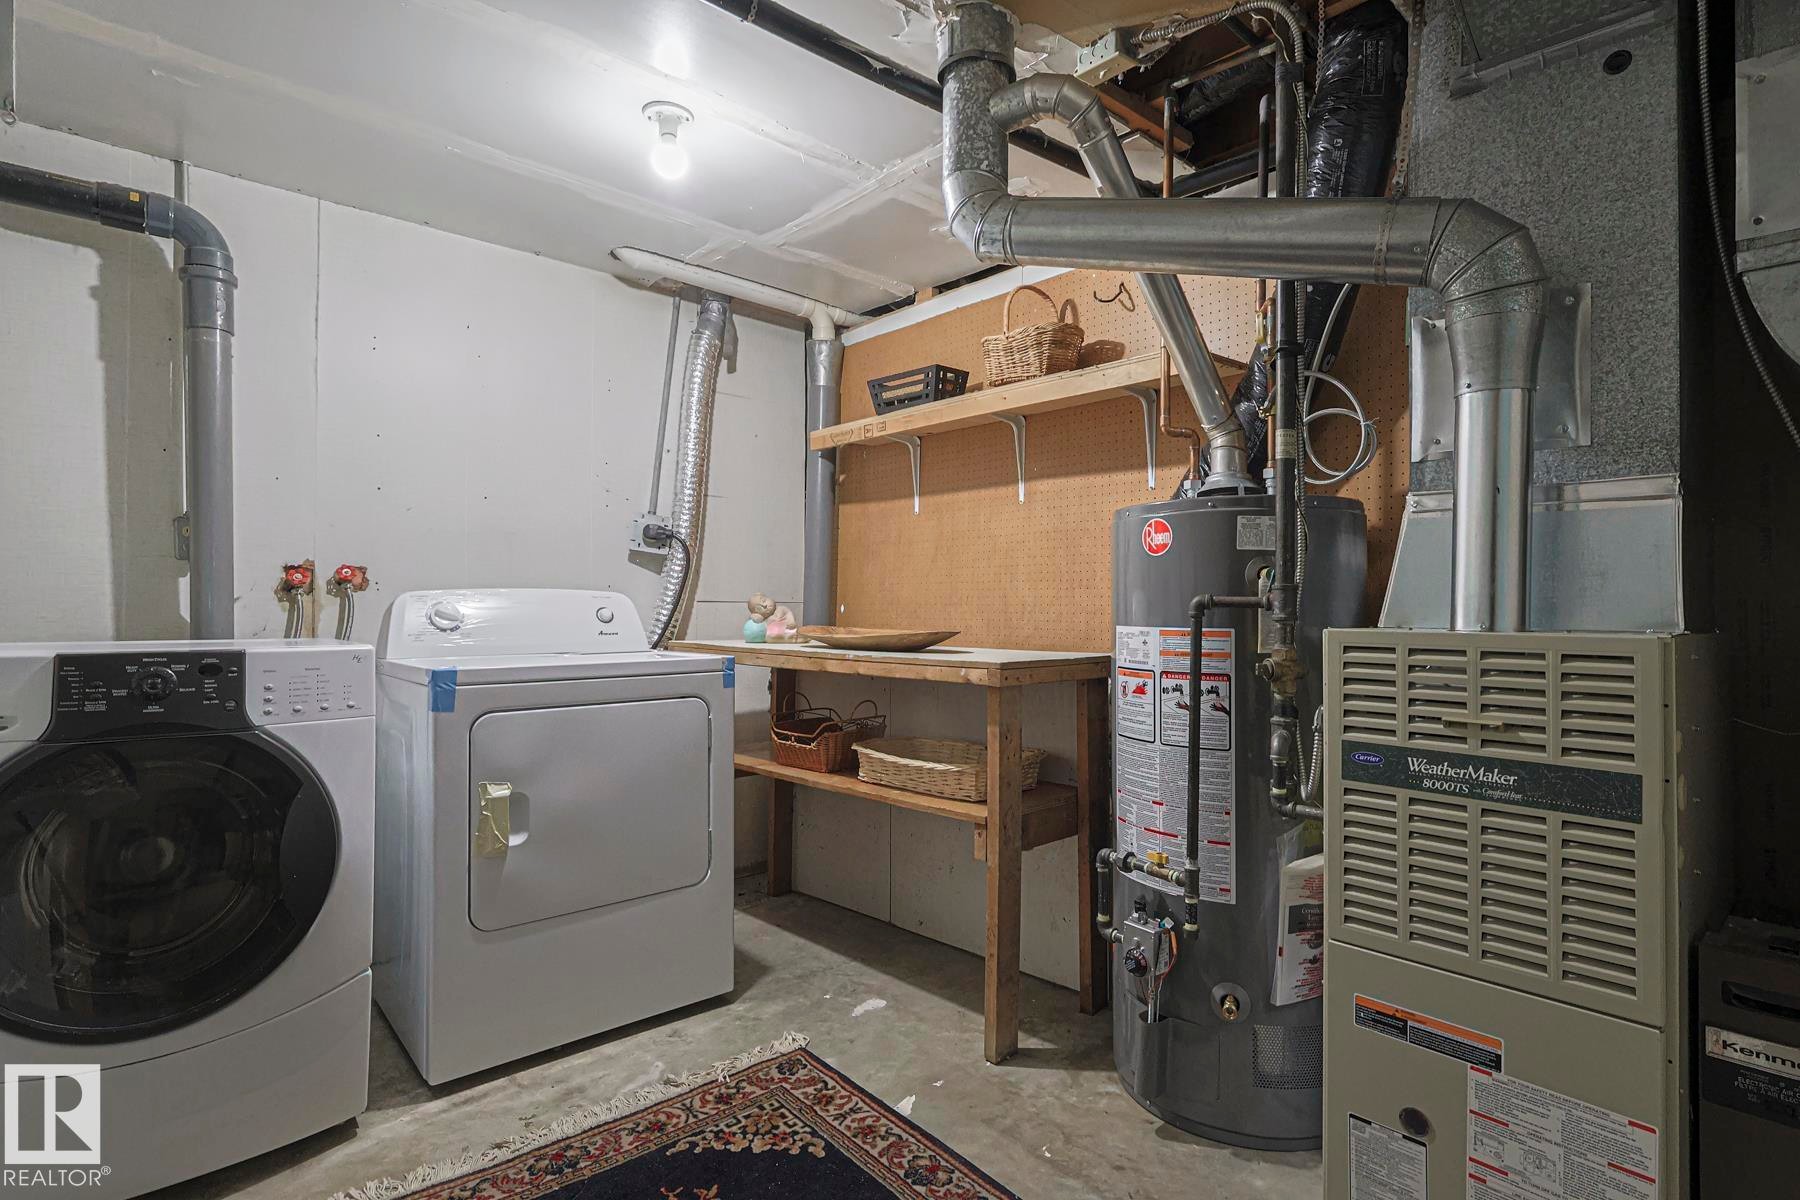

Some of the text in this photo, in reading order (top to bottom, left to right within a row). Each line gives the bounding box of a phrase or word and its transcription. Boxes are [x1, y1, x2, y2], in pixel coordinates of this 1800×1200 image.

[1146, 520, 1171, 550] Rheem
[1355, 753, 1381, 763] Carrier
[1407, 757, 1518, 786] WeatherMaker
[1422, 778, 1470, 794] 8000TS
[1722, 1040, 1800, 1070] Kenm
